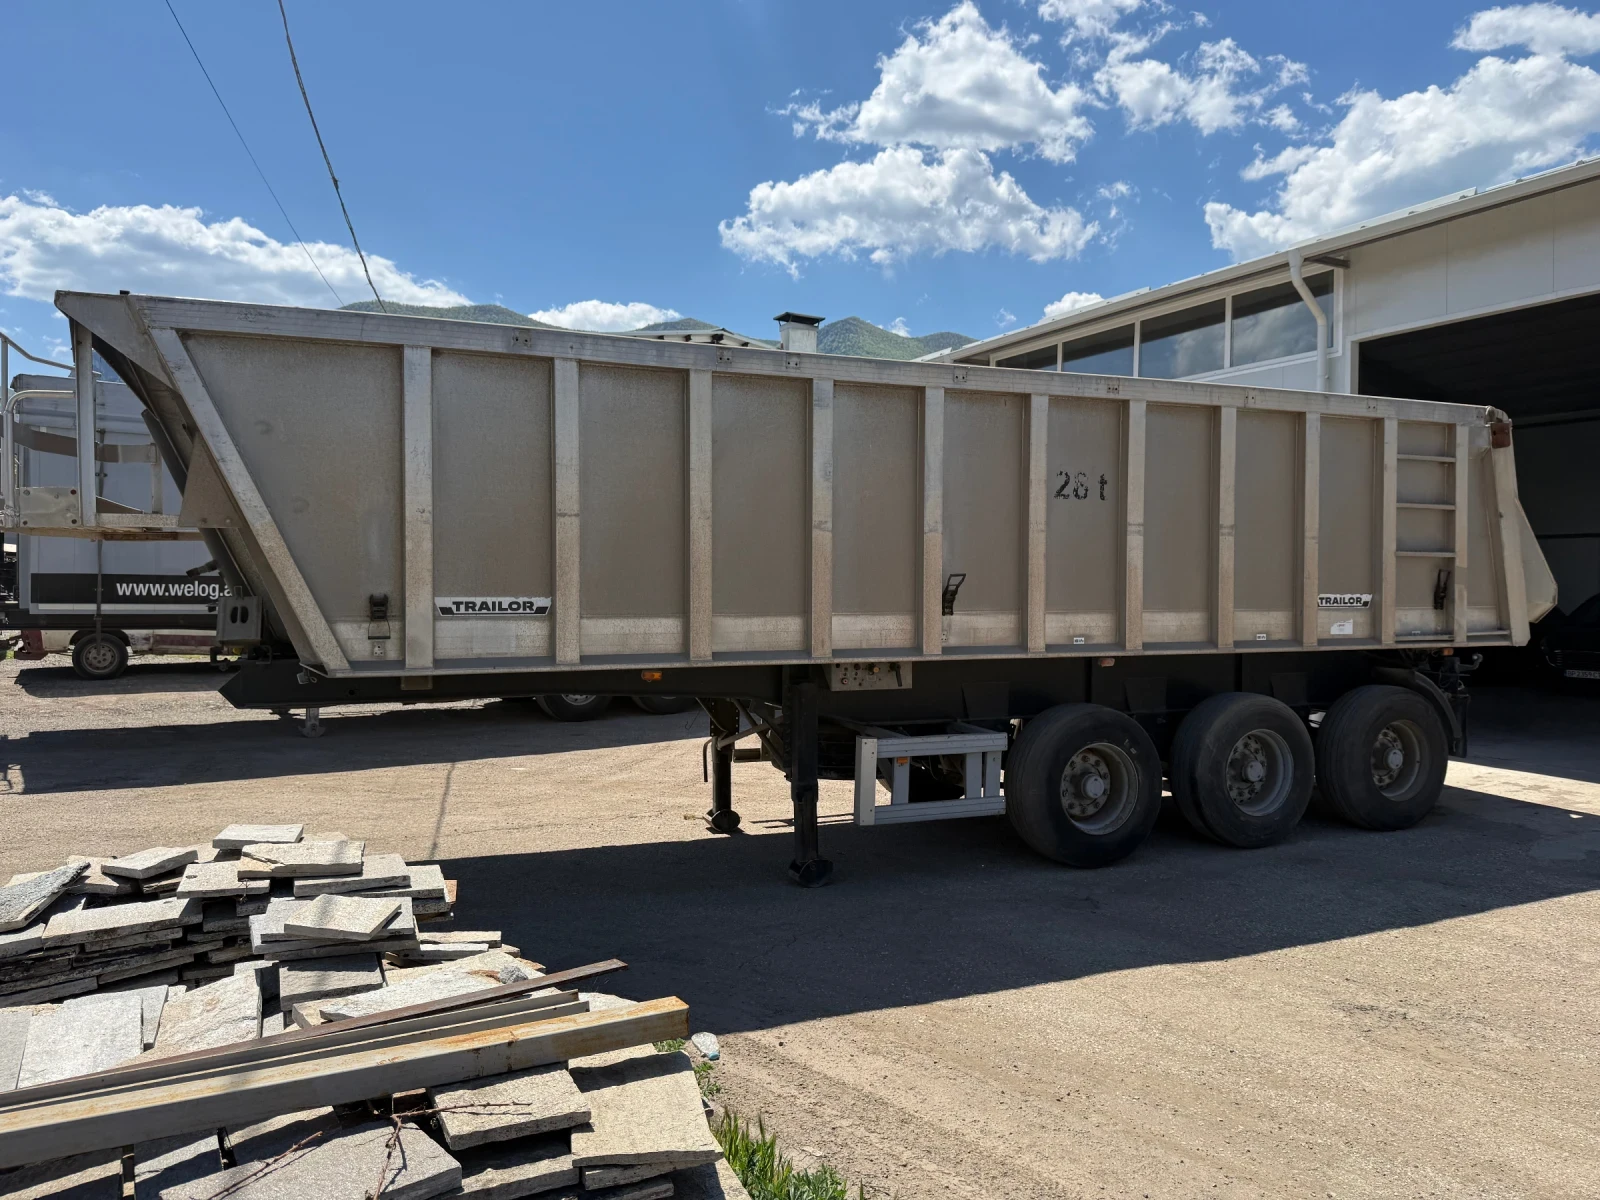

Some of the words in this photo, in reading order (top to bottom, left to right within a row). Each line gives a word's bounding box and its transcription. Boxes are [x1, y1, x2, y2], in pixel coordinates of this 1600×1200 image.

[1098, 473, 1108, 501] t
[452, 600, 535, 613] TRAILOR
[1318, 596, 1363, 605] TRAILOR
